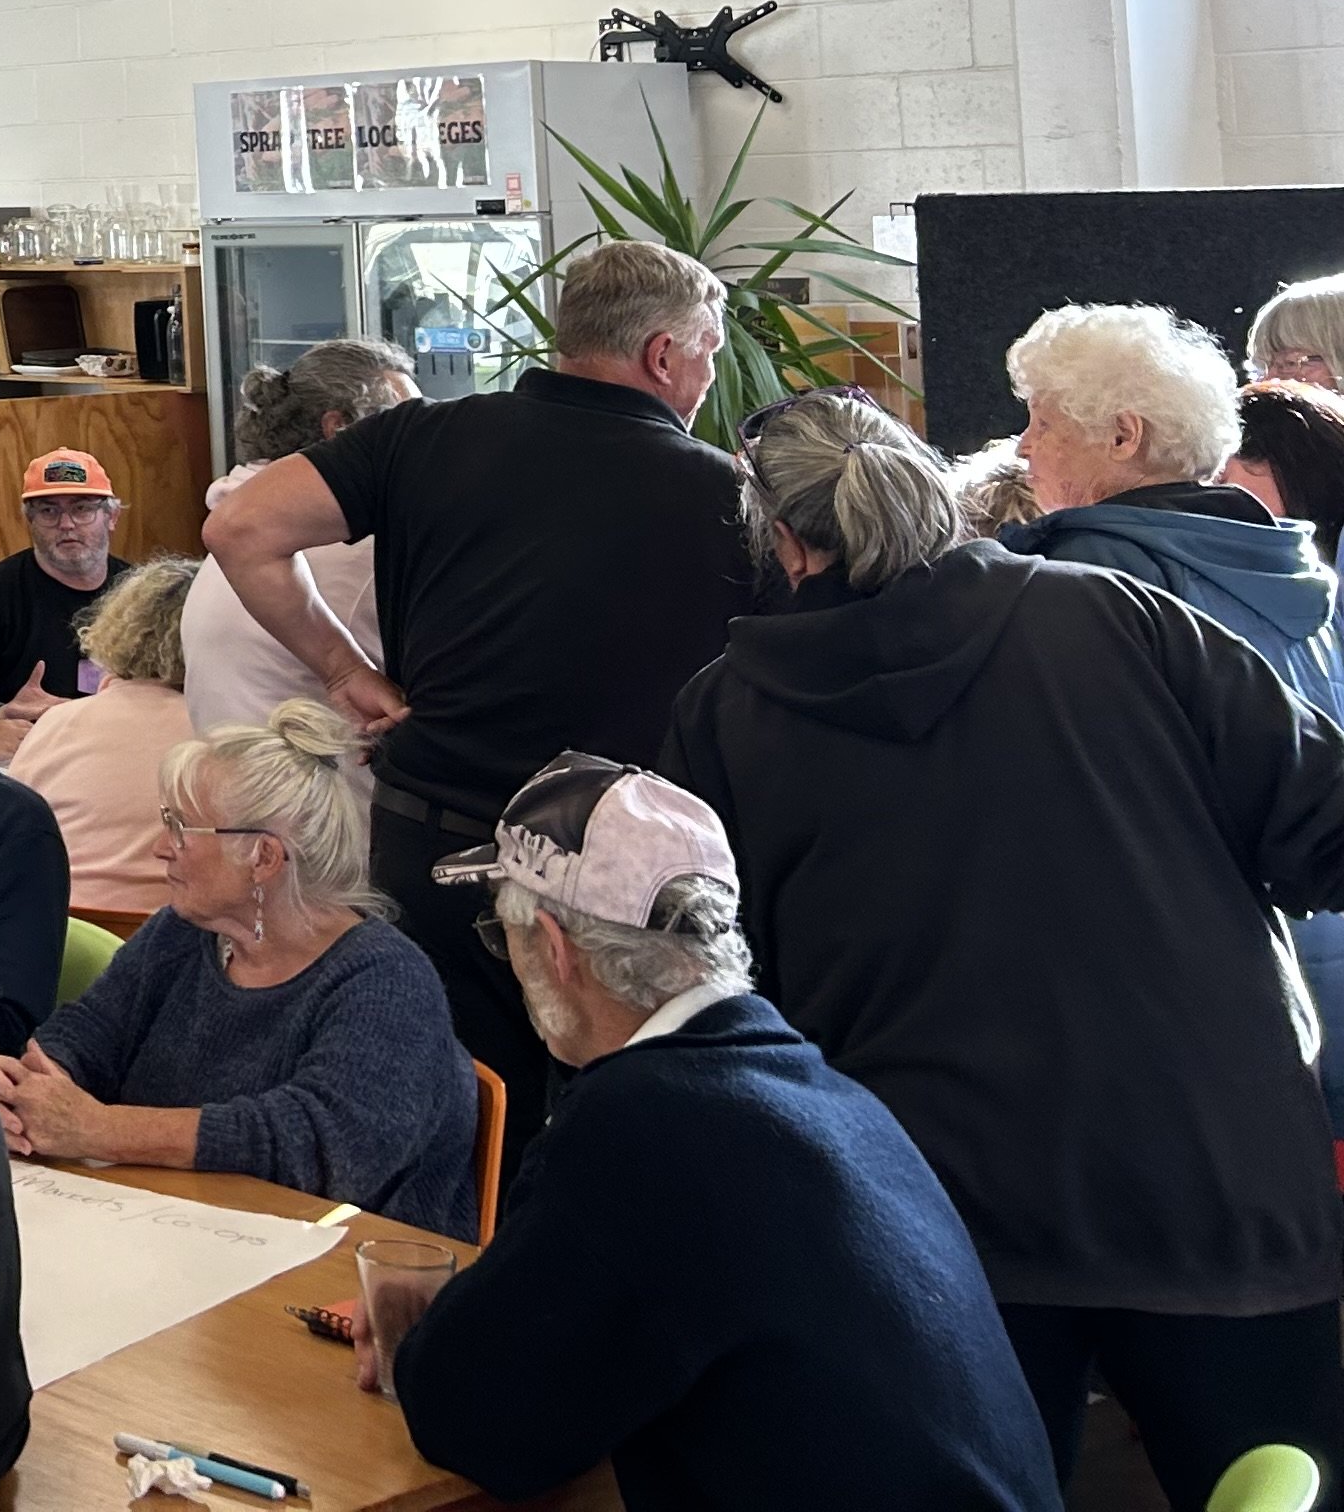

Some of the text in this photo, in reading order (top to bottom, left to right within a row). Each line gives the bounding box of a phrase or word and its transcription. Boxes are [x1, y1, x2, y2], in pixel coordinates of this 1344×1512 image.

[239, 130, 293, 153] SPRA
[357, 124, 400, 148] LOC
[439, 120, 482, 144] EGES
